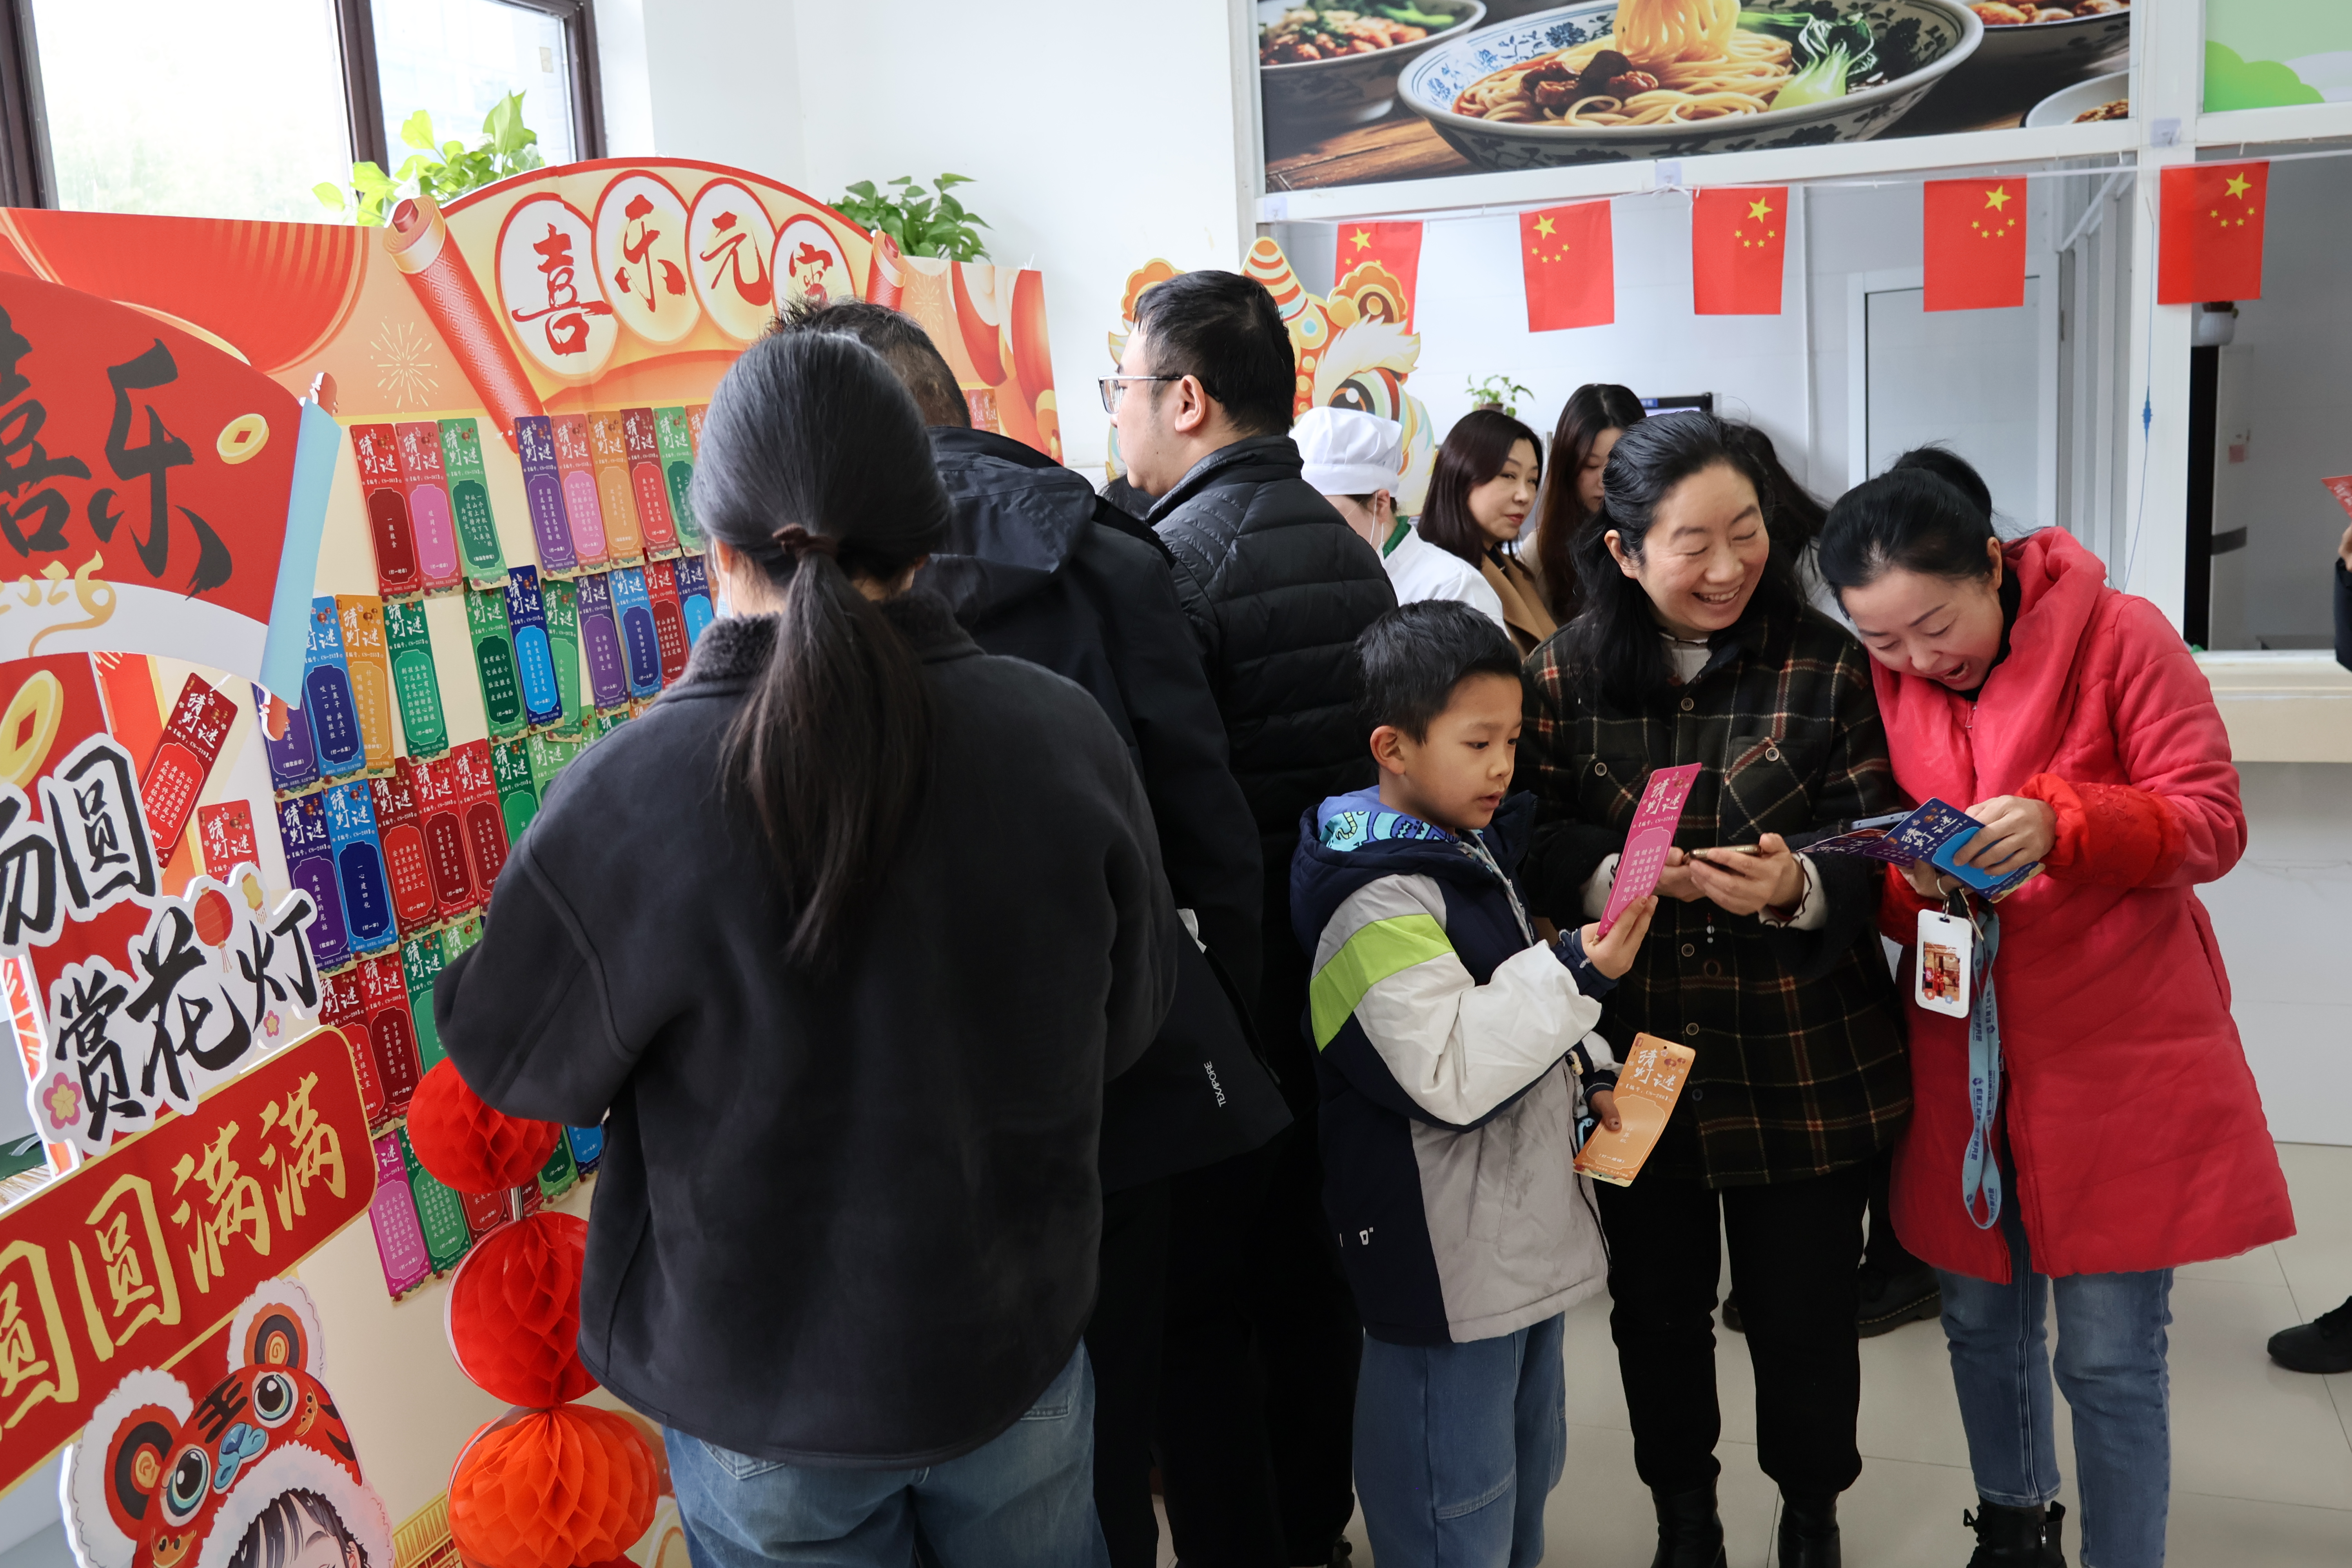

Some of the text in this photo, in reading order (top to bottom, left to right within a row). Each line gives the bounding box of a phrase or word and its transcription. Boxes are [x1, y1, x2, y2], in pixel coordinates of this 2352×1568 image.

[445, 428, 479, 466] 猜灯谜
[522, 426, 553, 462] 猜灯谜
[558, 424, 588, 459] 猜灯谜
[594, 421, 623, 455] 猜灯谜
[626, 417, 655, 451] 猜灯谜
[660, 416, 688, 448] 猜灯谜
[359, 434, 397, 474] 猜灯谜
[404, 432, 440, 470] 猜灯谜
[470, 591, 503, 623] 猜灯谜
[508, 577, 539, 614] 猜灯谜
[546, 590, 574, 626] 猜灯谜
[343, 607, 381, 648] 猜灯谜
[388, 604, 425, 637] 猜灯谜
[182, 693, 219, 749] 猜灯谜
[495, 746, 528, 780] 猜灯谜
[532, 733, 564, 766] 猜灯谜
[143, 760, 170, 812] 走起路来轻轻跳
[416, 763, 452, 800] 猜灯谜
[457, 754, 491, 790] 猜灯谜
[151, 765, 178, 818] 身披一件白皮袄
[160, 770, 186, 822] 长的耳朵短尾巴
[168, 776, 193, 828] 红的眼睛白的毛
[330, 788, 370, 828] 猜灯谜
[375, 779, 413, 813] 猜灯谜
[1646, 779, 1682, 815] 猜灯谜
[208, 815, 252, 858] 猜灯谜
[284, 802, 326, 844] 猜灯谜
[1901, 815, 1958, 848] 猜灯谜
[364, 960, 401, 995] 猜灯谜
[407, 940, 442, 978] 猜灯谜
[320, 978, 359, 1013] 猜灯谜
[56, 898, 312, 1141] 赏花灯
[1634, 1048, 1676, 1092] 猜灯谜
